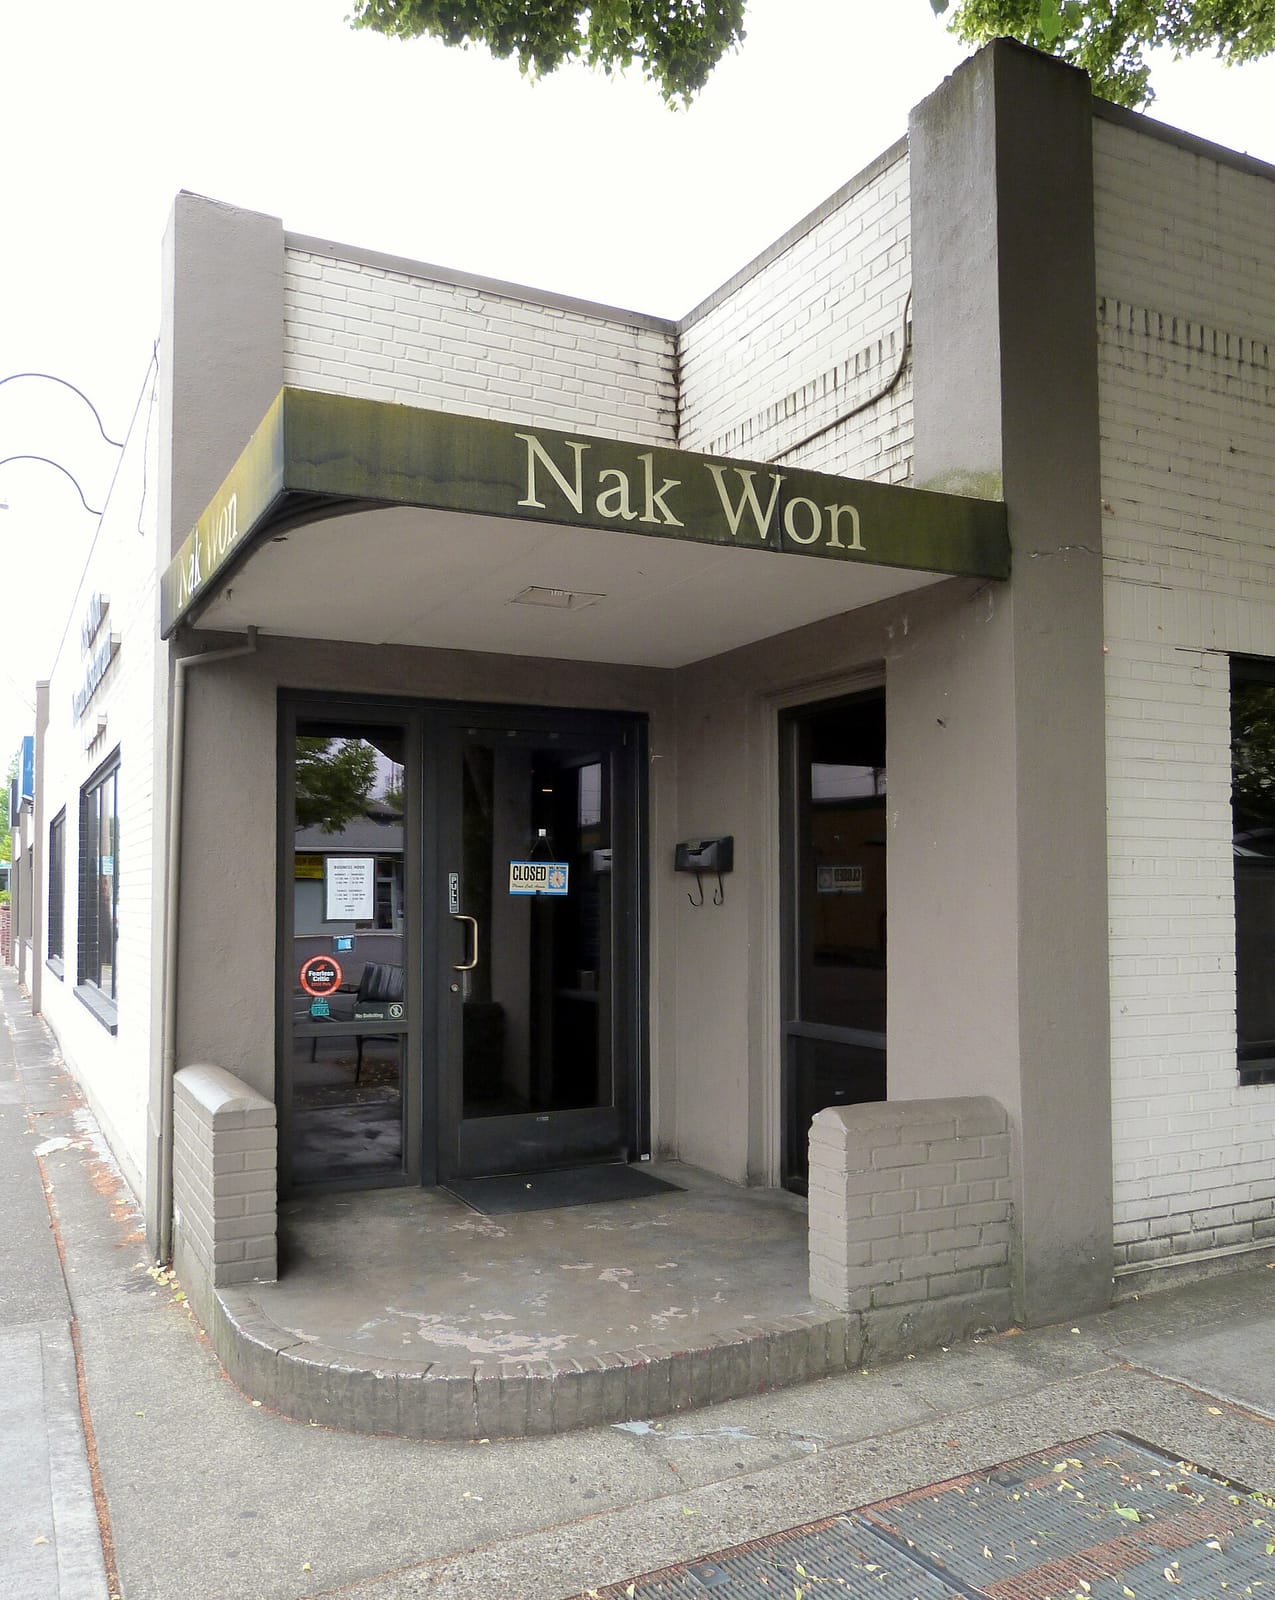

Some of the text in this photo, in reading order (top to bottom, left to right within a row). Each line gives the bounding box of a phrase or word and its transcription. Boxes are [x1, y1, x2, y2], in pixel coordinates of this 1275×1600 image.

[514, 432, 867, 551] Nak Won
[178, 492, 238, 608] Nak Won
[513, 866, 546, 881] CLOSED
